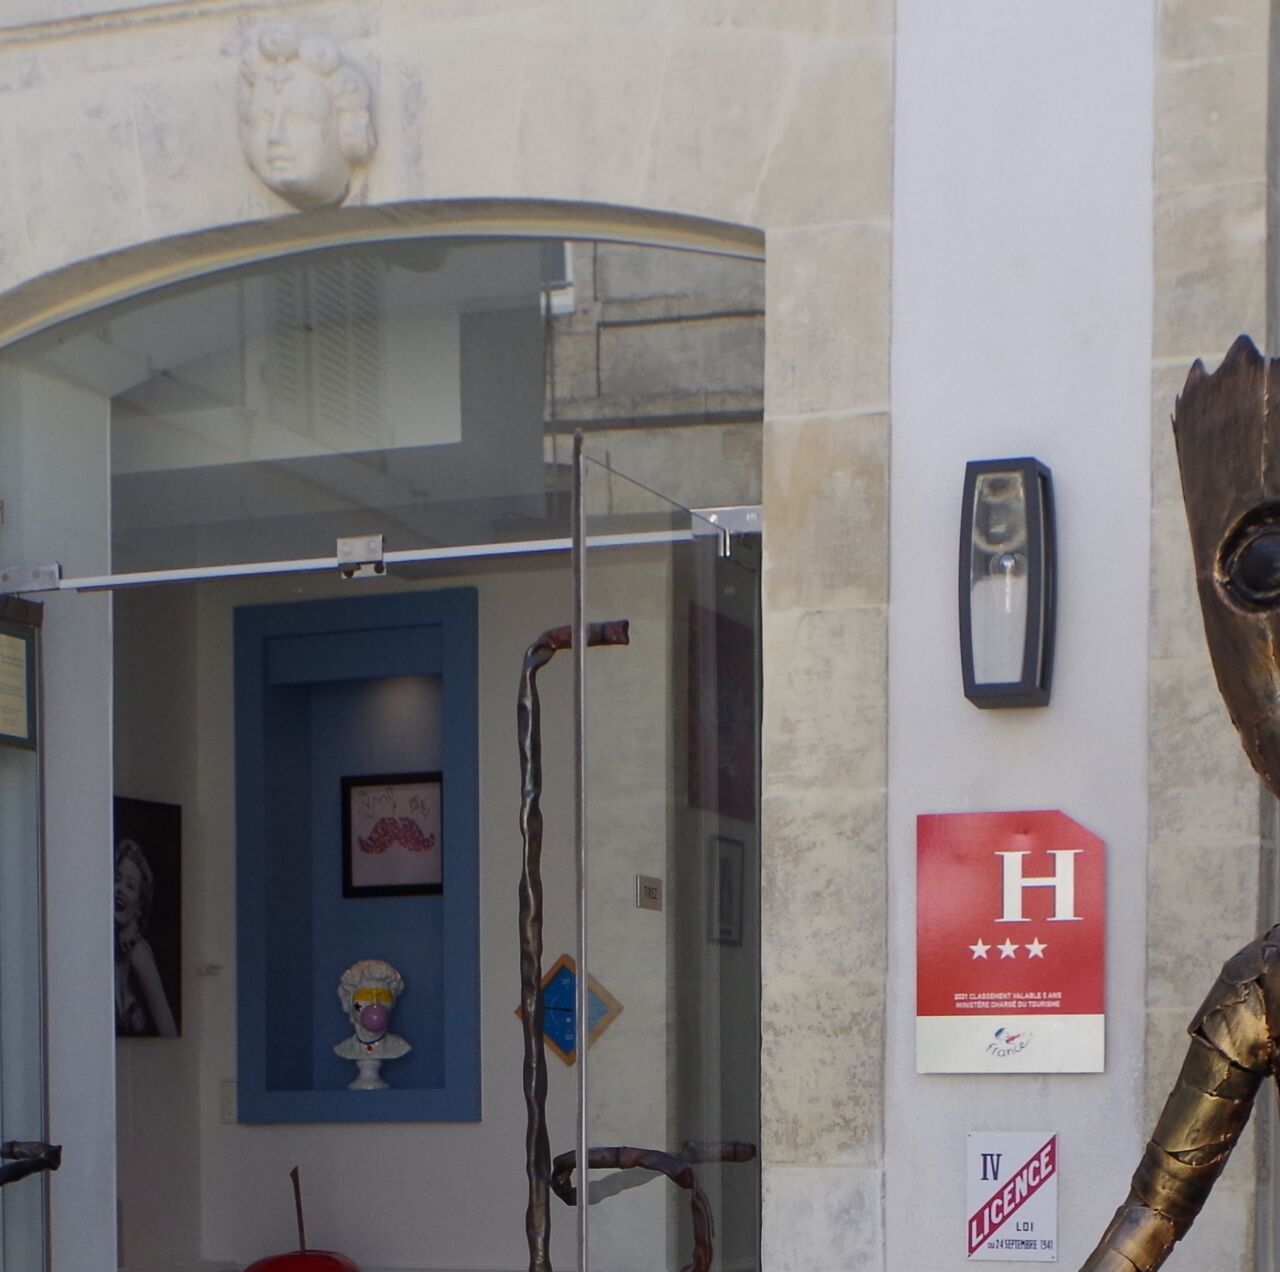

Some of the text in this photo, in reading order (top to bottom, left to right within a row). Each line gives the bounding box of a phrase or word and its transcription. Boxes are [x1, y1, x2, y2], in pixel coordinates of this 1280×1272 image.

[994, 849, 1084, 922] H
[969, 992, 1012, 1000] CLASSEMENT
[1048, 991, 1062, 999] ANS
[1028, 1000, 1060, 1008] TOURISME
[981, 1153, 1002, 1181] IV
[971, 1144, 1053, 1248] LICENCE
[1016, 1222, 1034, 1232] LOI
[996, 1240, 1004, 1249] 24
[1005, 1240, 1037, 1250] SEPTEMBRE
